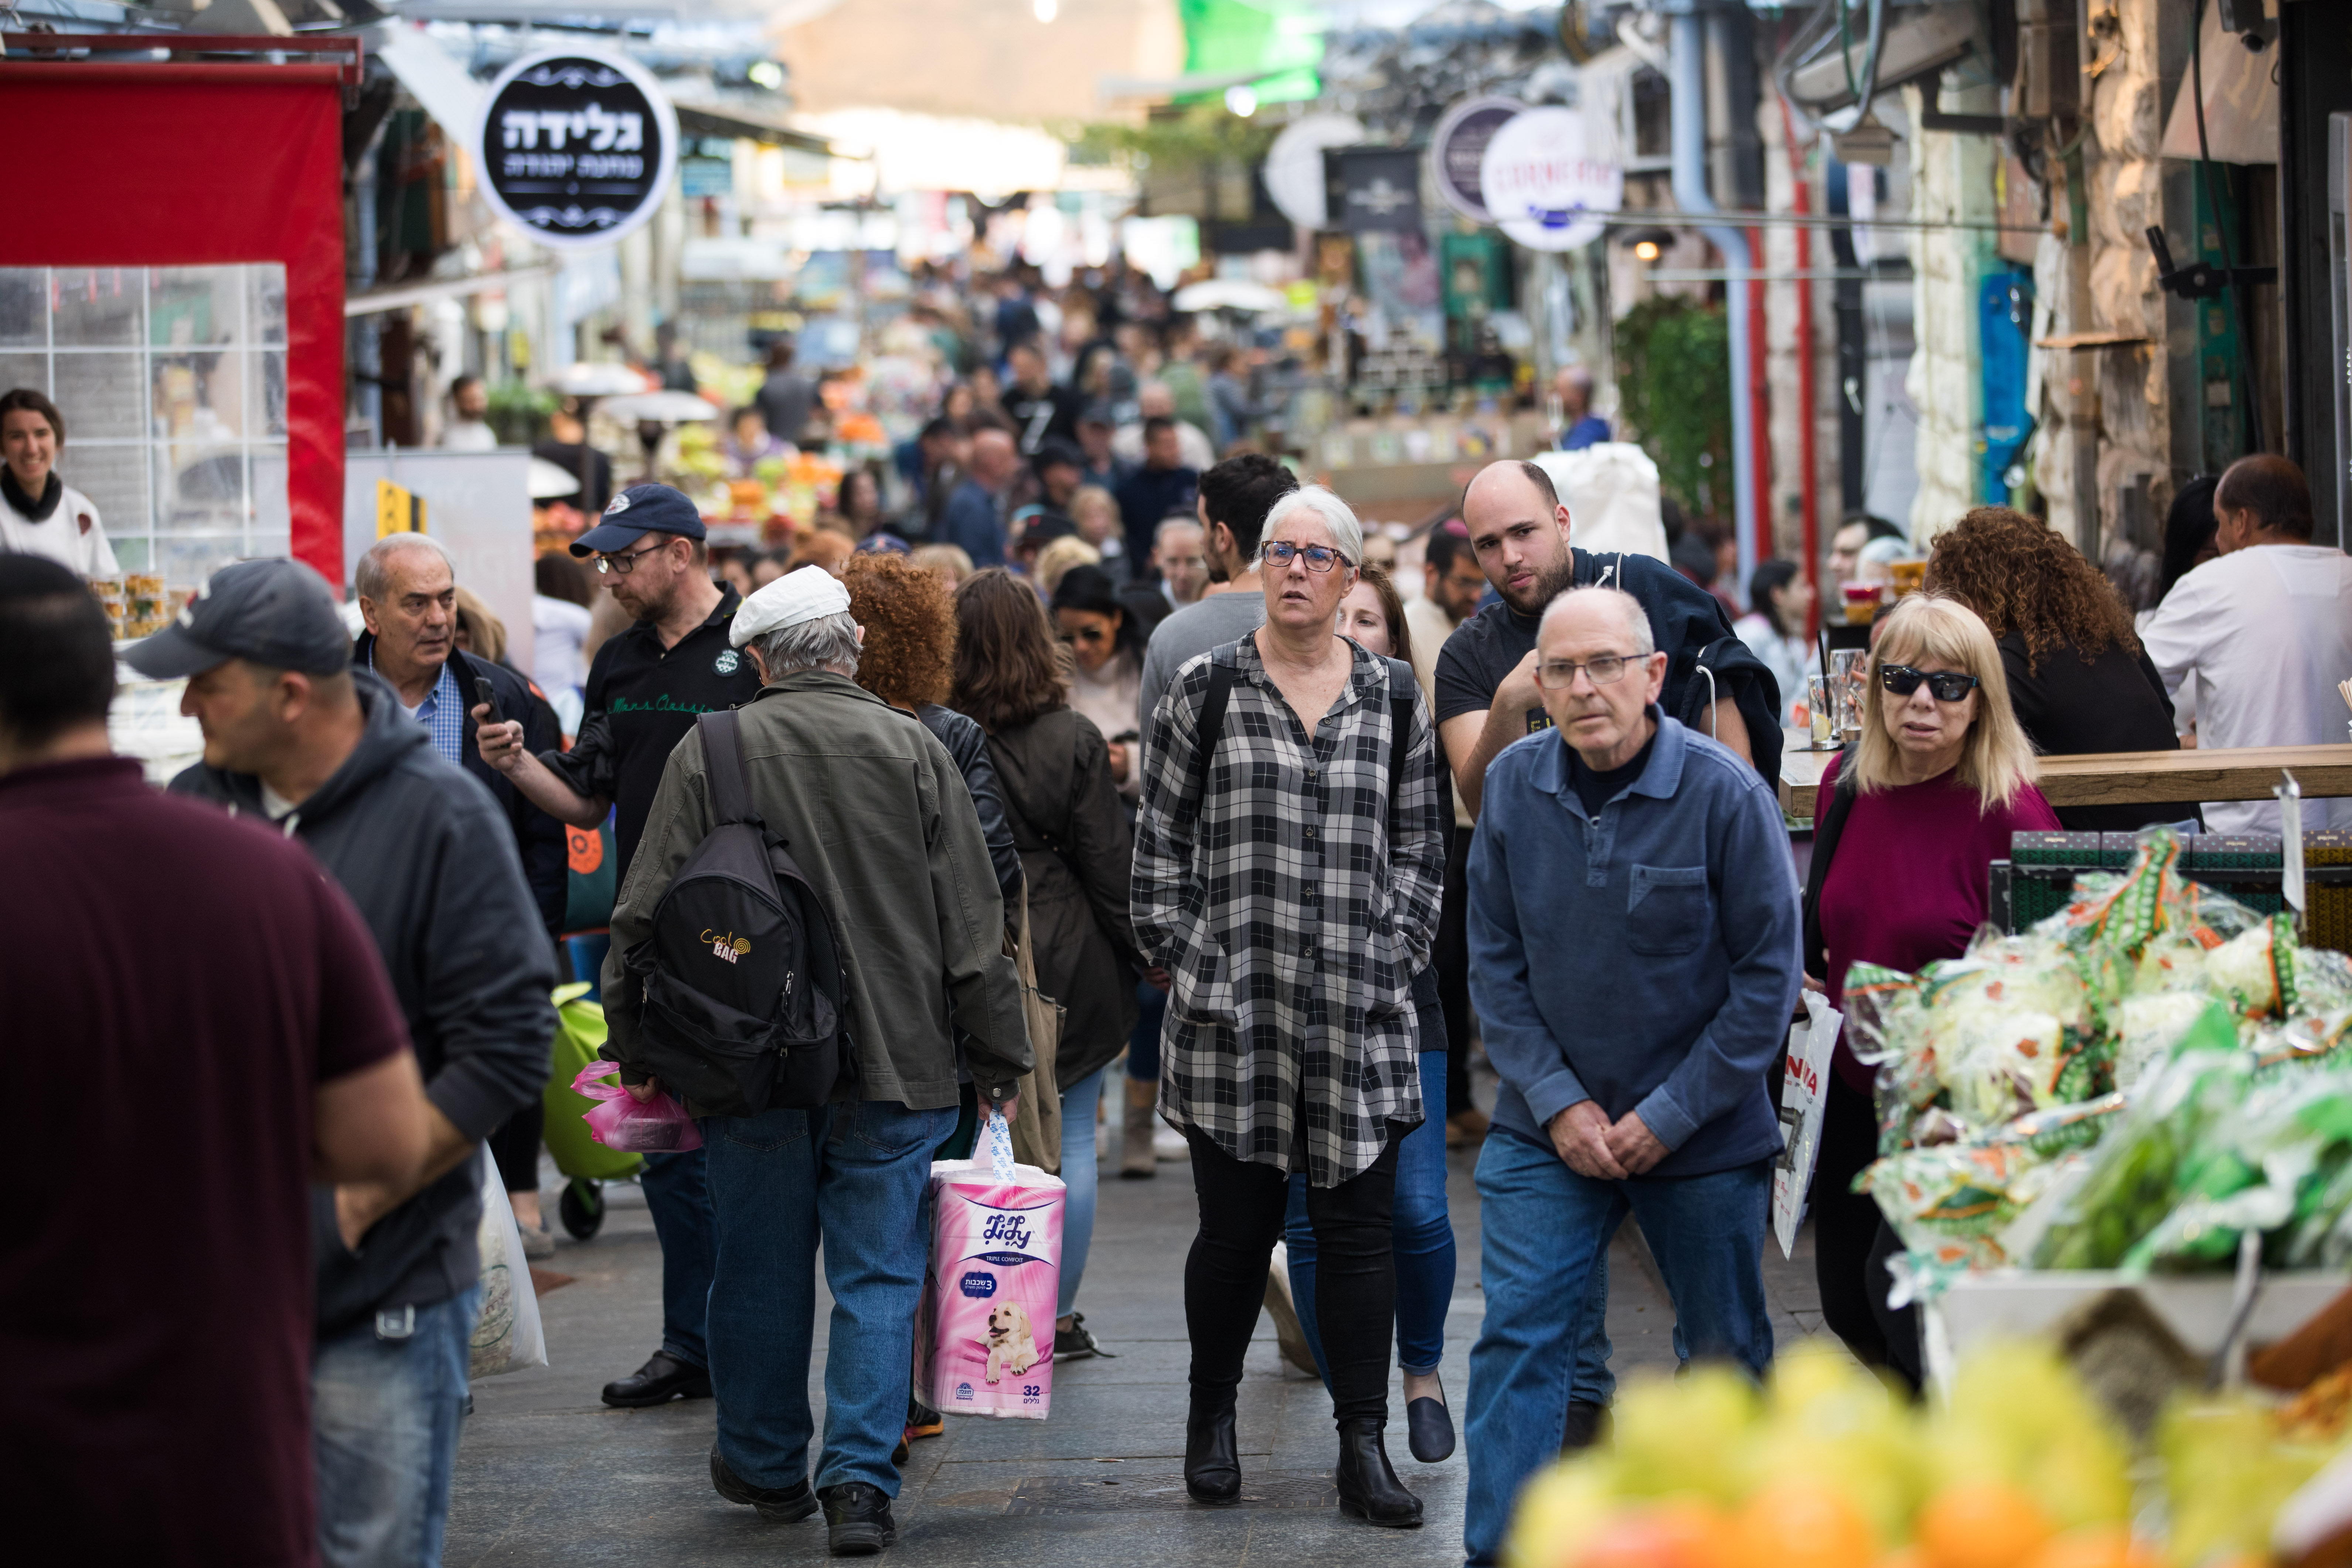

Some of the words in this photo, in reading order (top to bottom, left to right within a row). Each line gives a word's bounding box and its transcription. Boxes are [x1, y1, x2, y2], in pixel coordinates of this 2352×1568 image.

[502, 102, 644, 151] גלידה
[701, 929, 732, 947] Cool
[713, 942, 739, 964] BAG
[986, 1280, 992, 1290] 3
[1023, 1385, 1040, 1396] 32
